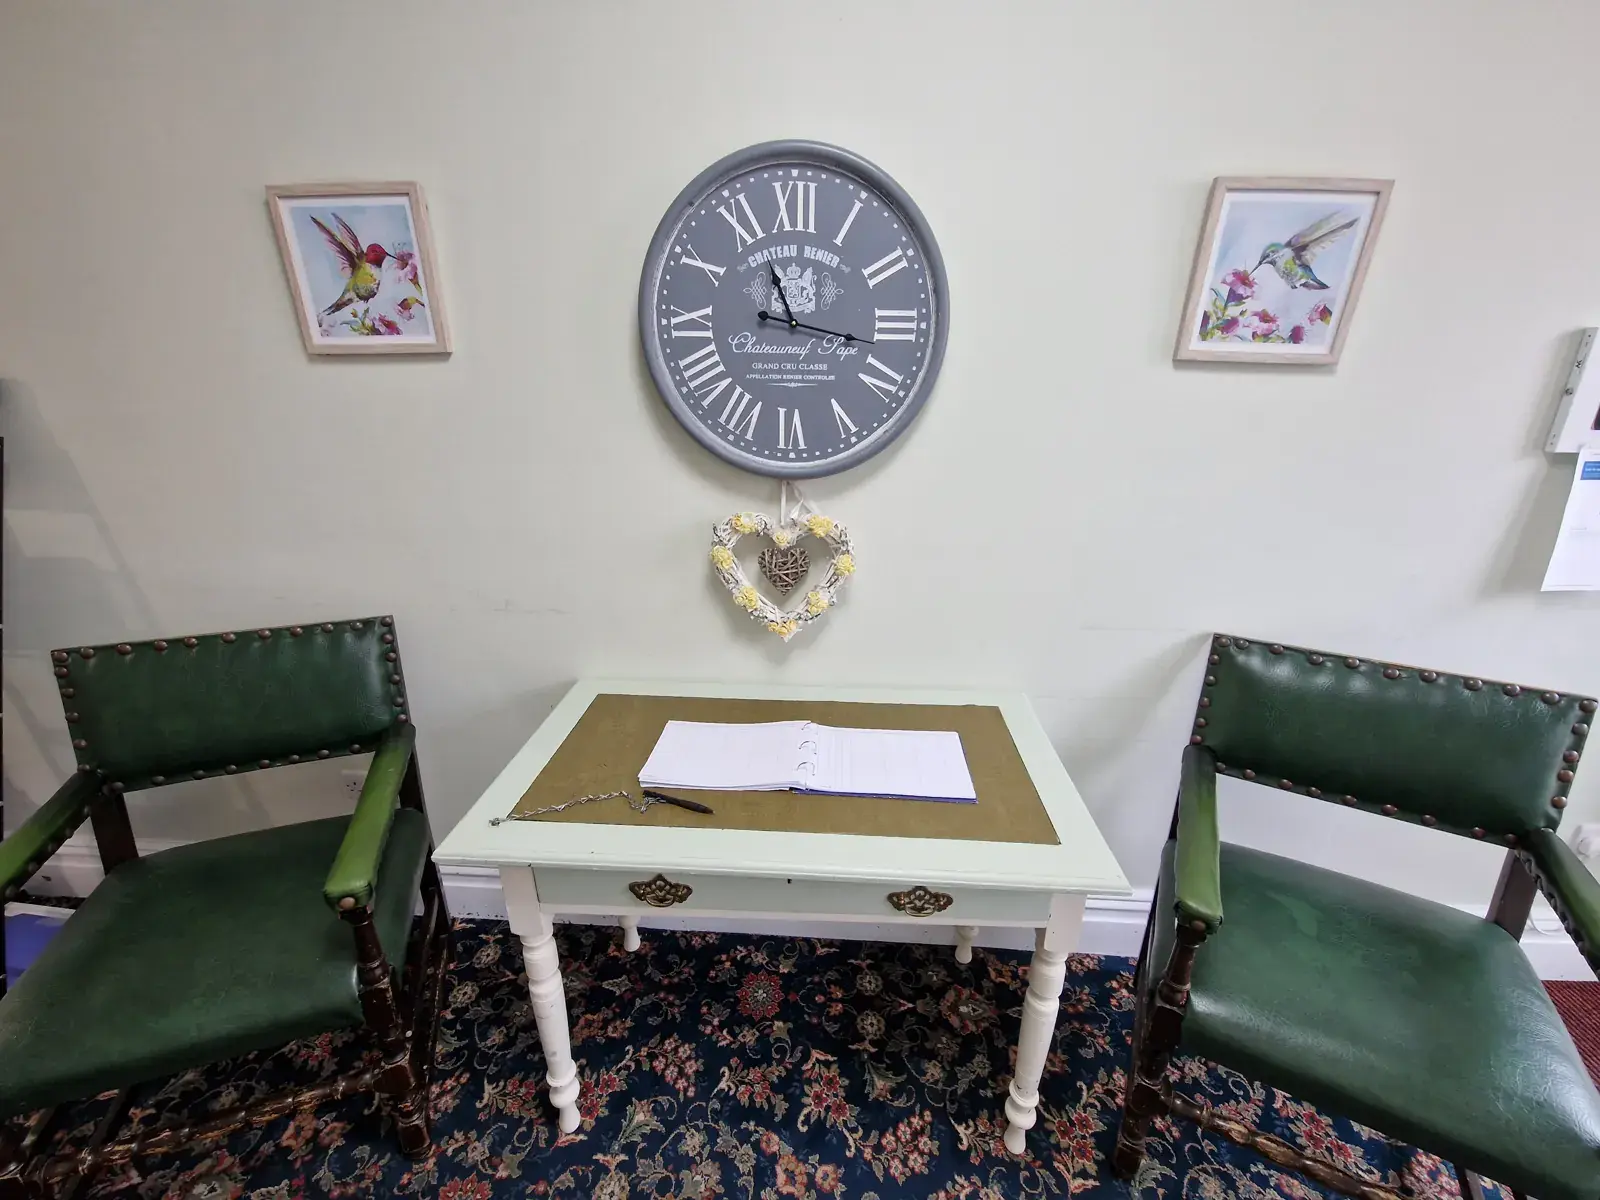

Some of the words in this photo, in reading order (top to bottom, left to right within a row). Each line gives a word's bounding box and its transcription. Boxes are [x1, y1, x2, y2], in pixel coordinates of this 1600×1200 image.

[717, 193, 765, 252] XI
[772, 181, 817, 233] XII
[833, 200, 862, 246] I
[680, 244, 726, 287] X
[748, 245, 797, 267] CHATEAU
[804, 246, 840, 268] RENIER
[862, 247, 908, 288] II
[671, 305, 712, 338] IX
[874, 308, 917, 343] III
[728, 332, 816, 360] Chateauneuf
[799, 363, 828, 371] CLASSE
[678, 341, 732, 409] VIII
[858, 354, 904, 402] IV
[718, 384, 762, 440] VII
[777, 407, 807, 450] VI
[831, 398, 858, 437] V
